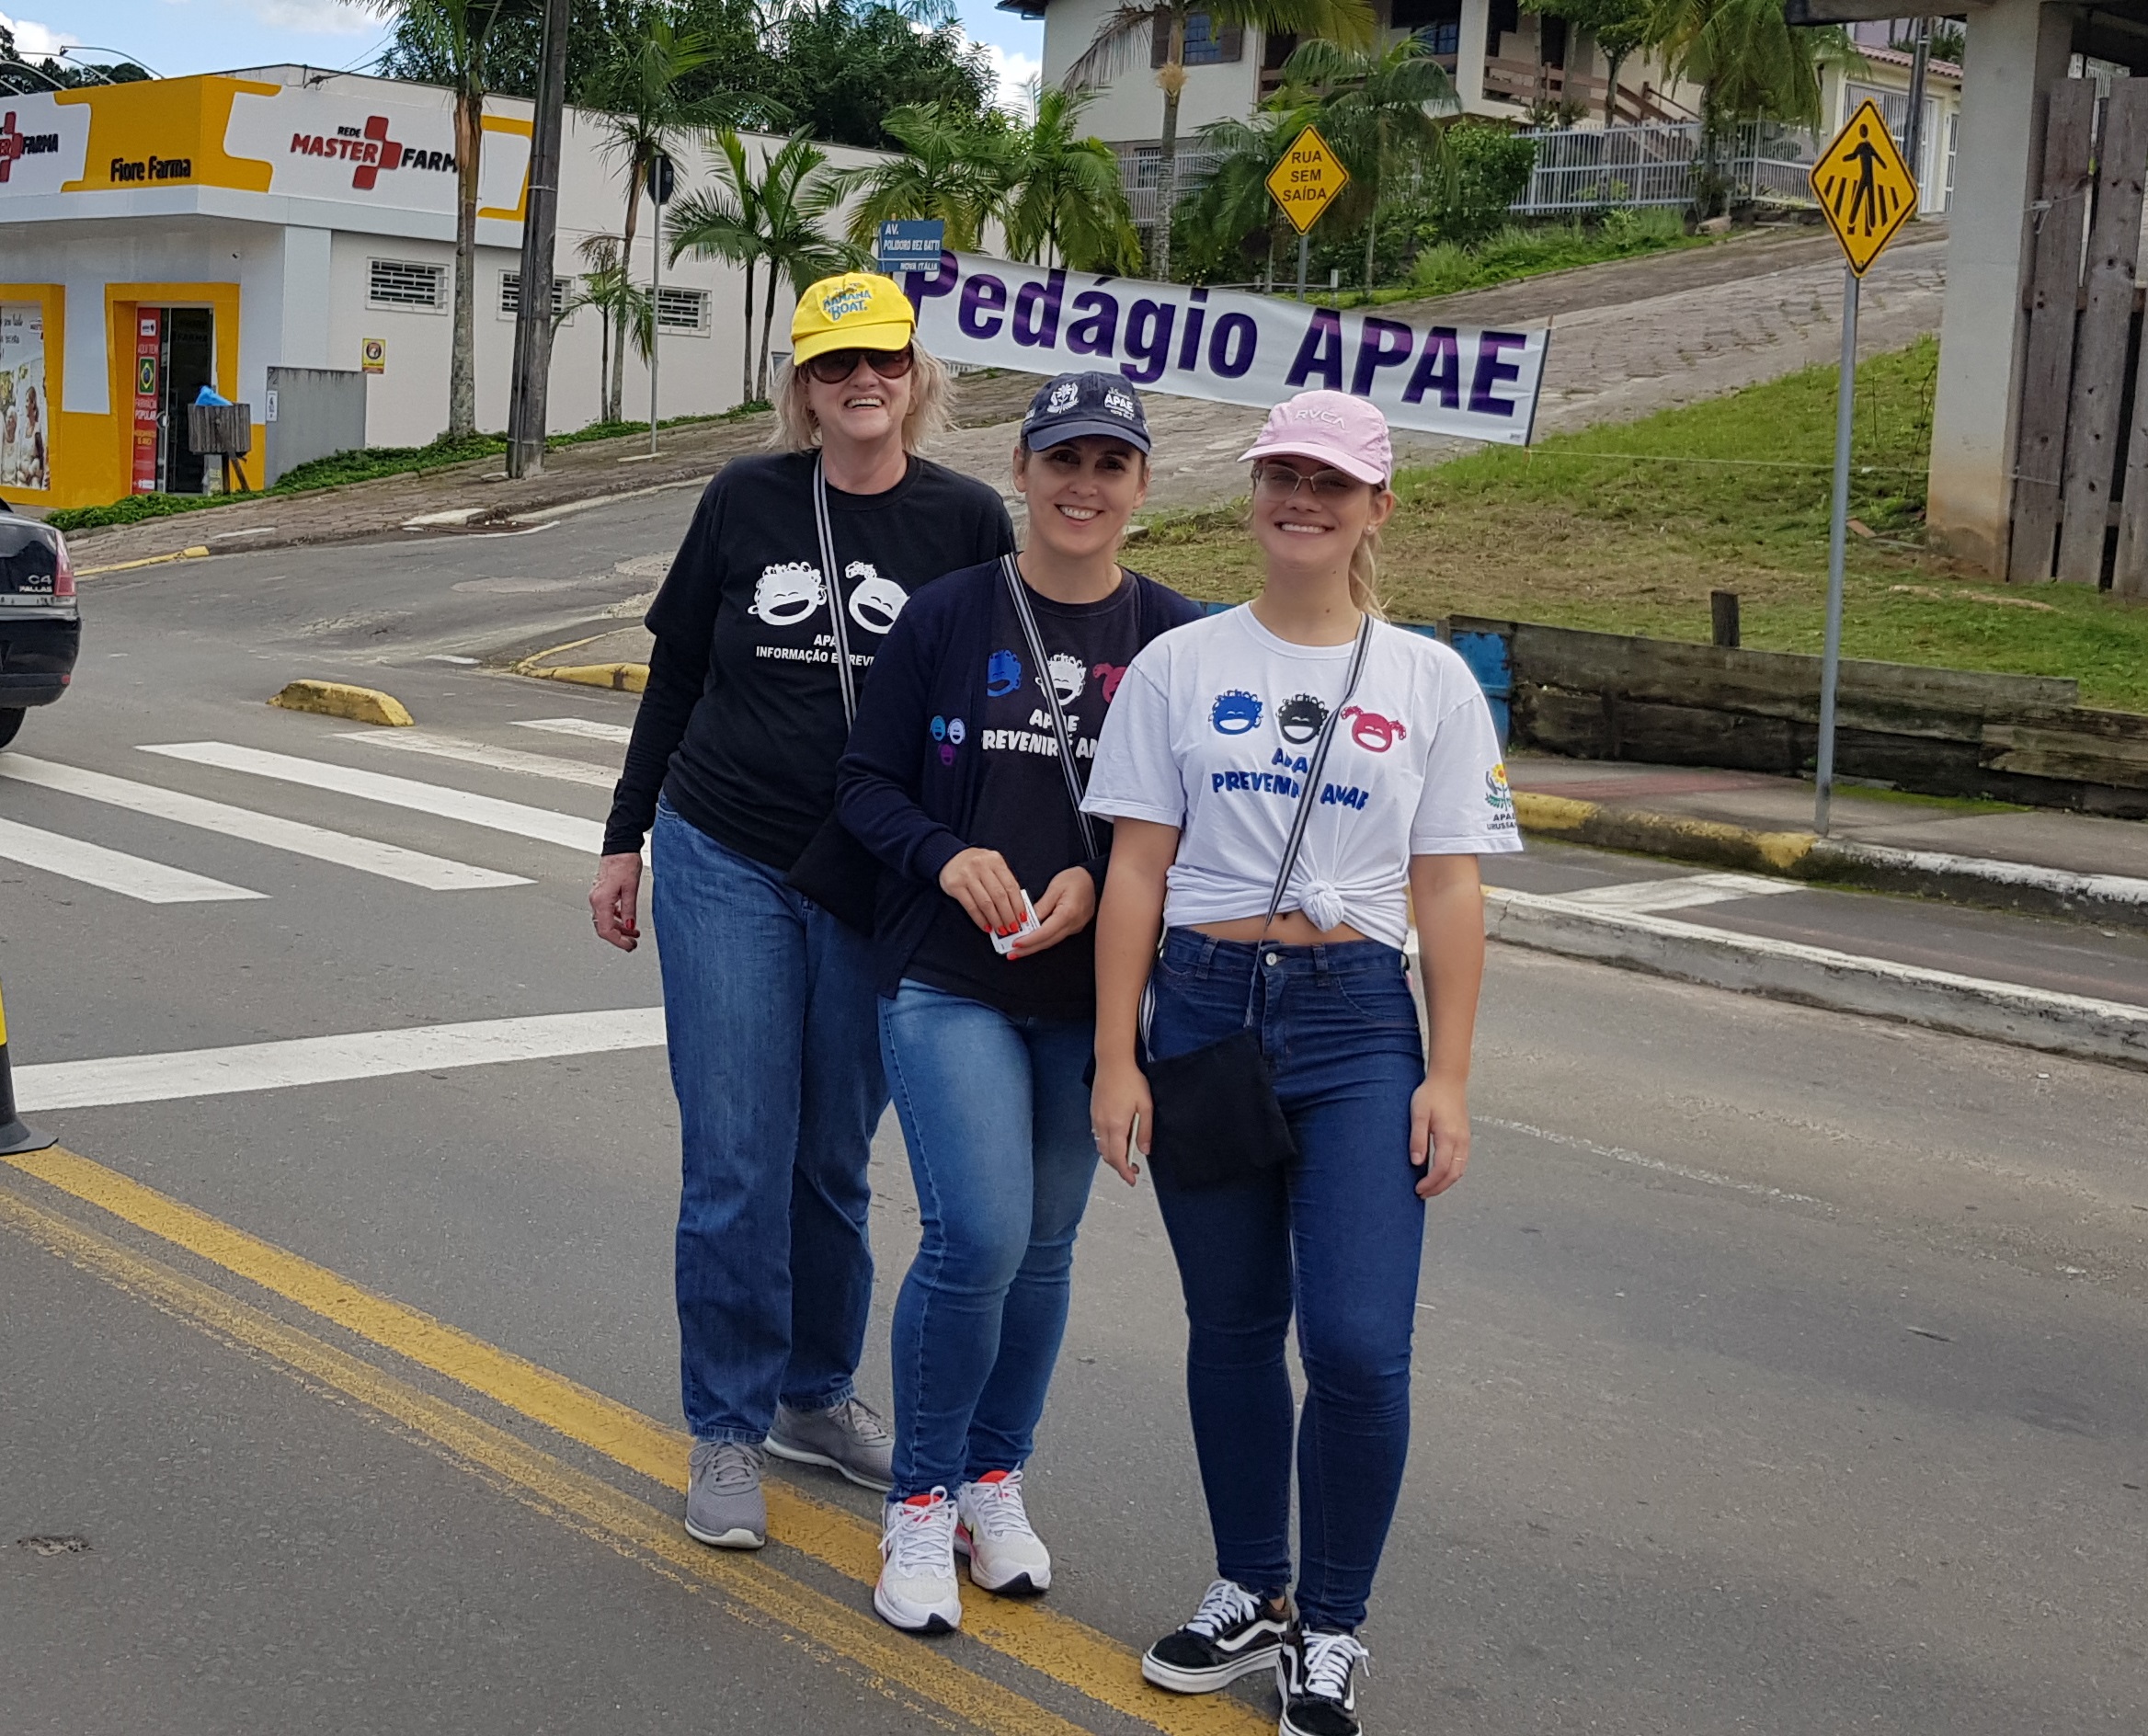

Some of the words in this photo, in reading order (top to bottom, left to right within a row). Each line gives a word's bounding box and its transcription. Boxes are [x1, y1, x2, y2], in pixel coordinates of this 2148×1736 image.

[337, 125, 361, 138] REDE
[22, 133, 59, 154] FARMA
[290, 132, 379, 164] MASTER
[401, 147, 458, 173] FARM
[1291, 150, 1322, 164] RUA
[110, 157, 144, 182] Fiore
[148, 155, 191, 179] Farma
[1290, 168, 1321, 182] SEM
[1282, 186, 1327, 202] SAÍDA
[885, 223, 899, 235] AV.
[904, 248, 1258, 384] Pedágio
[1285, 307, 1527, 417] APAE
[1104, 394, 1134, 412] APAE
[1294, 409, 1346, 430] RVCA
[28, 574, 52, 585] C4
[814, 634, 839, 647] APA
[756, 645, 828, 664] INFORMAÇÃO
[831, 652, 839, 664] E
[981, 729, 1059, 757] REVENIR
